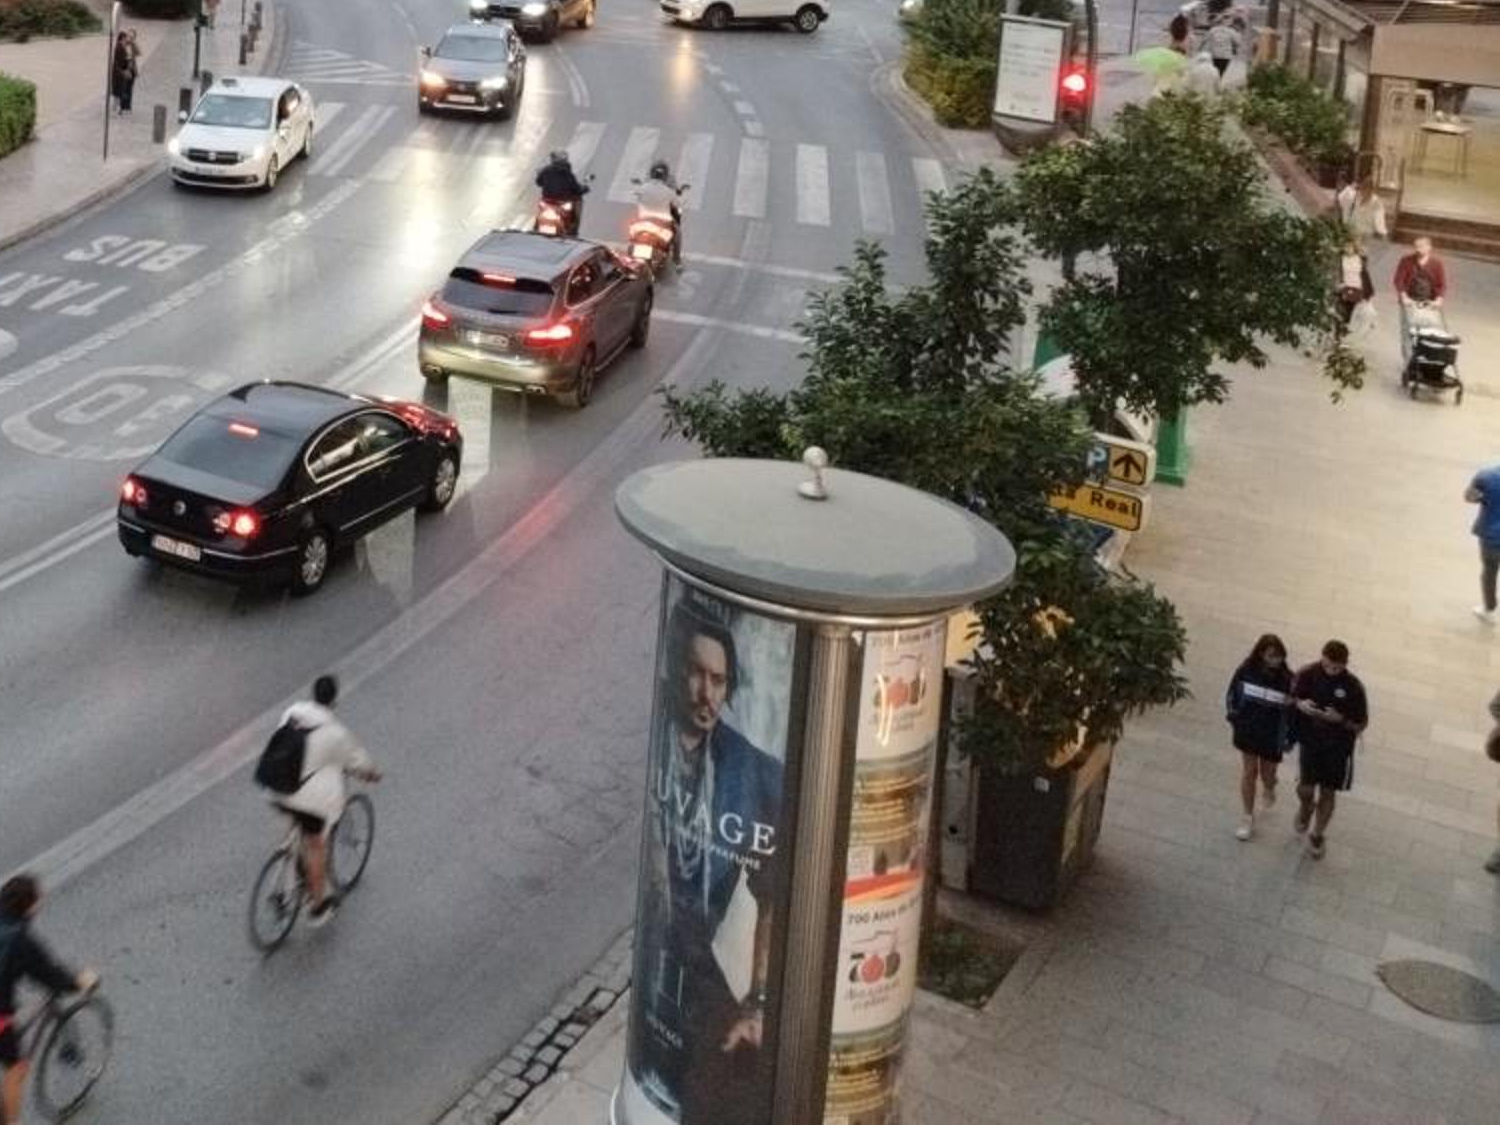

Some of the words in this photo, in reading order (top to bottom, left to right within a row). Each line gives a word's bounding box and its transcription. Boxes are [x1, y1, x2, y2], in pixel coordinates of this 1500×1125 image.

[63, 235, 208, 273] BUS
[1090, 490, 1137, 518] Real
[656, 767, 777, 856] UVAGE
